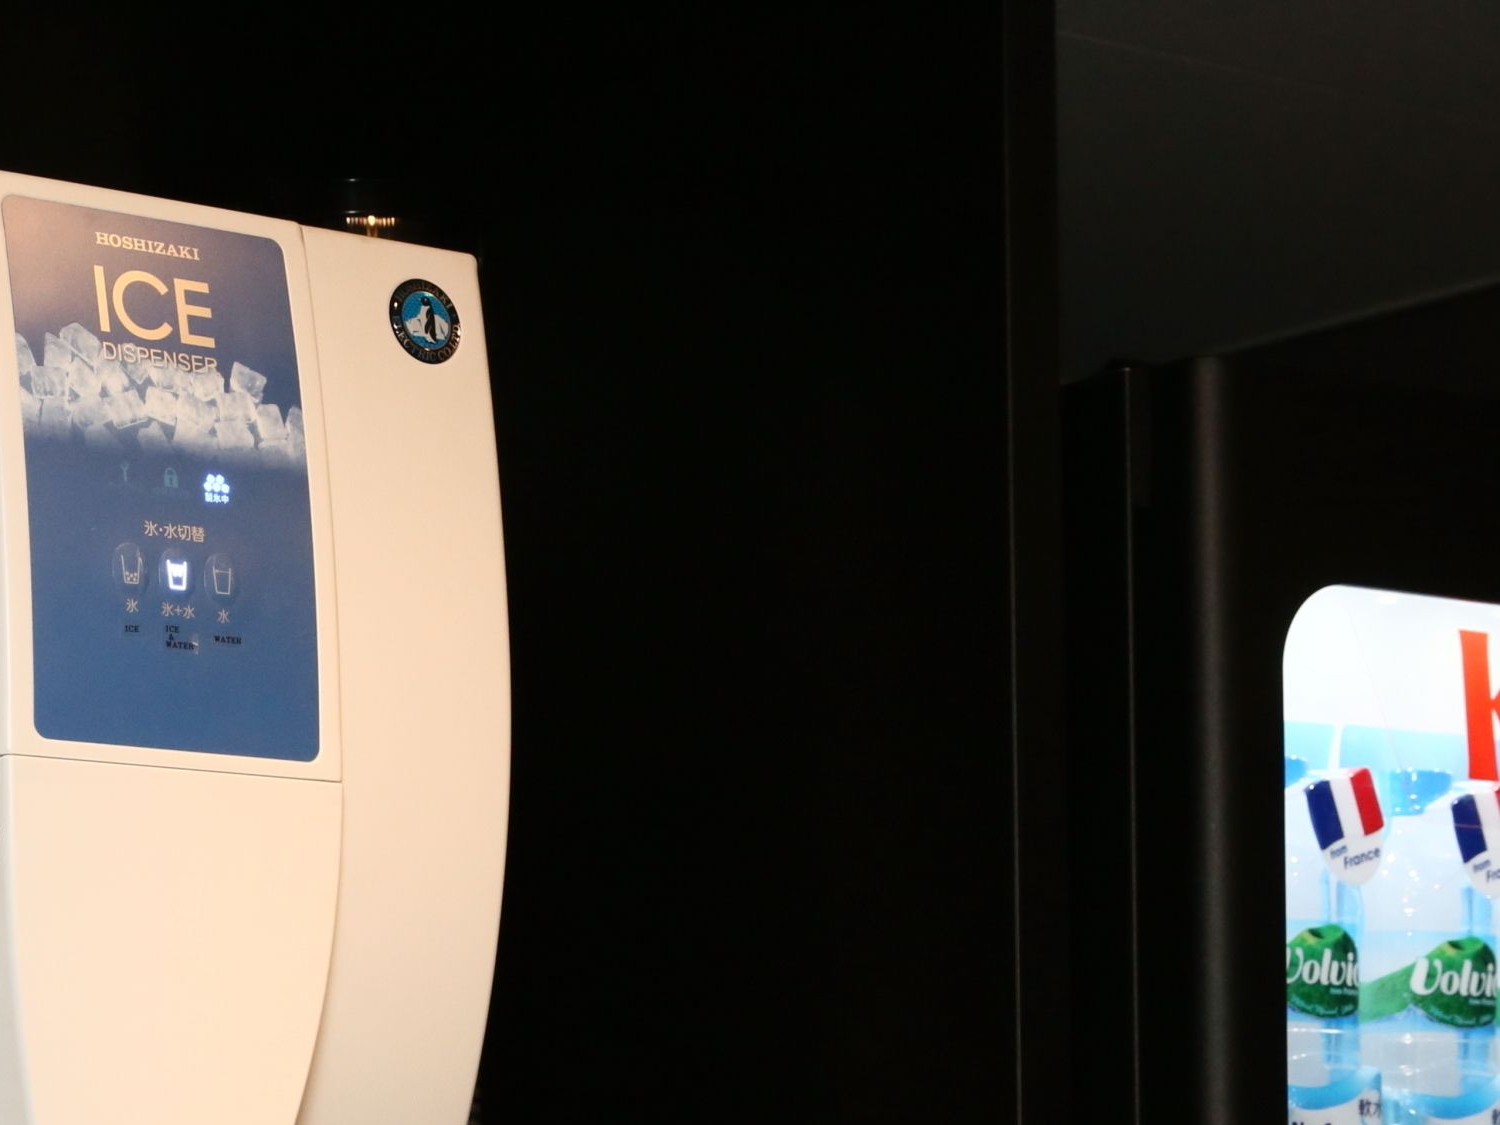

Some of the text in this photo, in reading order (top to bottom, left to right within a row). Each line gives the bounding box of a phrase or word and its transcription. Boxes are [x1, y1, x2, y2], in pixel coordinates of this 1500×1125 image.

[94, 231, 200, 260] HOSHIZAKI
[93, 264, 216, 349] ICE
[102, 340, 218, 374] DISPENSER
[125, 598, 139, 613] 氷
[217, 609, 230, 624] 水
[125, 624, 140, 633] ICE
[165, 625, 180, 634] ICE
[165, 640, 194, 650] WATER
[213, 635, 242, 645] WATER
[1344, 847, 1381, 870] France
